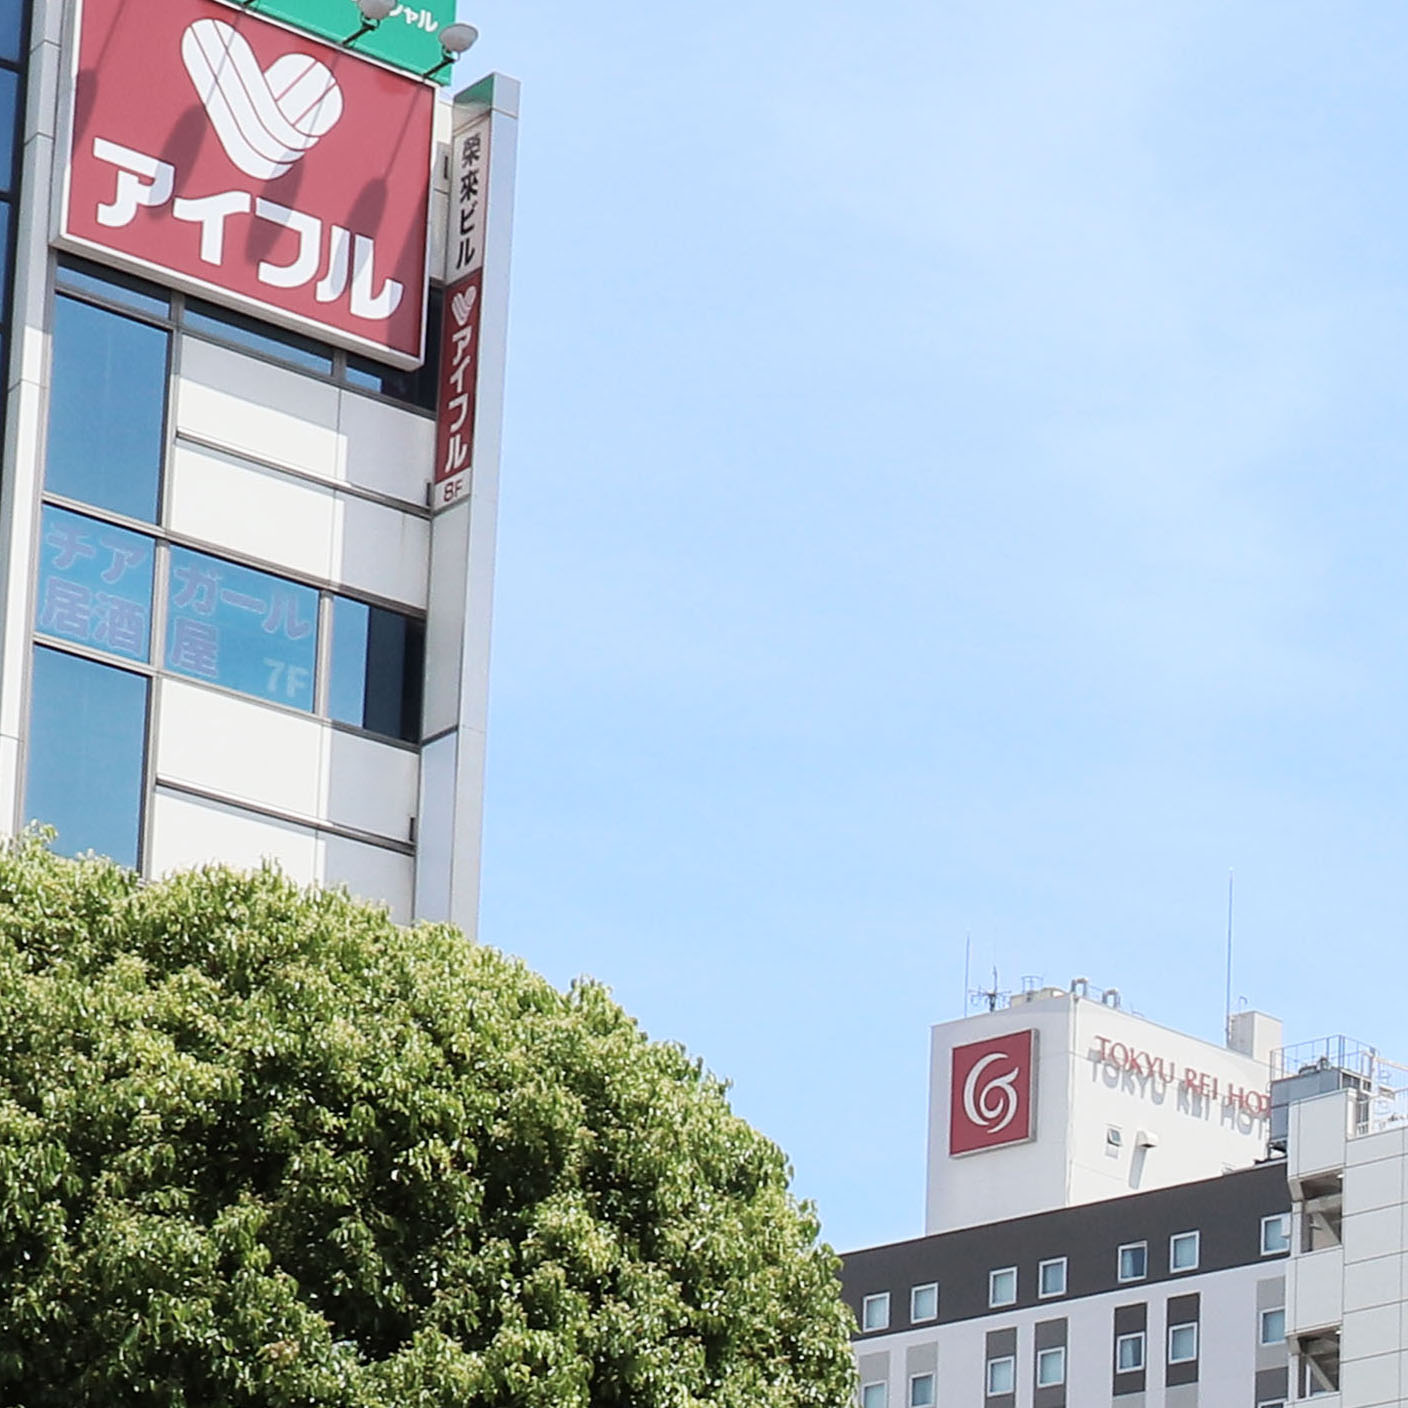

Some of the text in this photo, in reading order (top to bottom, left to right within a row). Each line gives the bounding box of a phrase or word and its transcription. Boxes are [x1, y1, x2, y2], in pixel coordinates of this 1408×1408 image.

[92, 137, 404, 320] アイフル
[444, 326, 473, 474] アイフル
[443, 479, 463, 502] 8F
[39, 576, 310, 698] 居酒屋 7F
[47, 522, 313, 640] チアガール
[1095, 1035, 1175, 1084] TOKYU
[1185, 1068, 1218, 1101] REI
